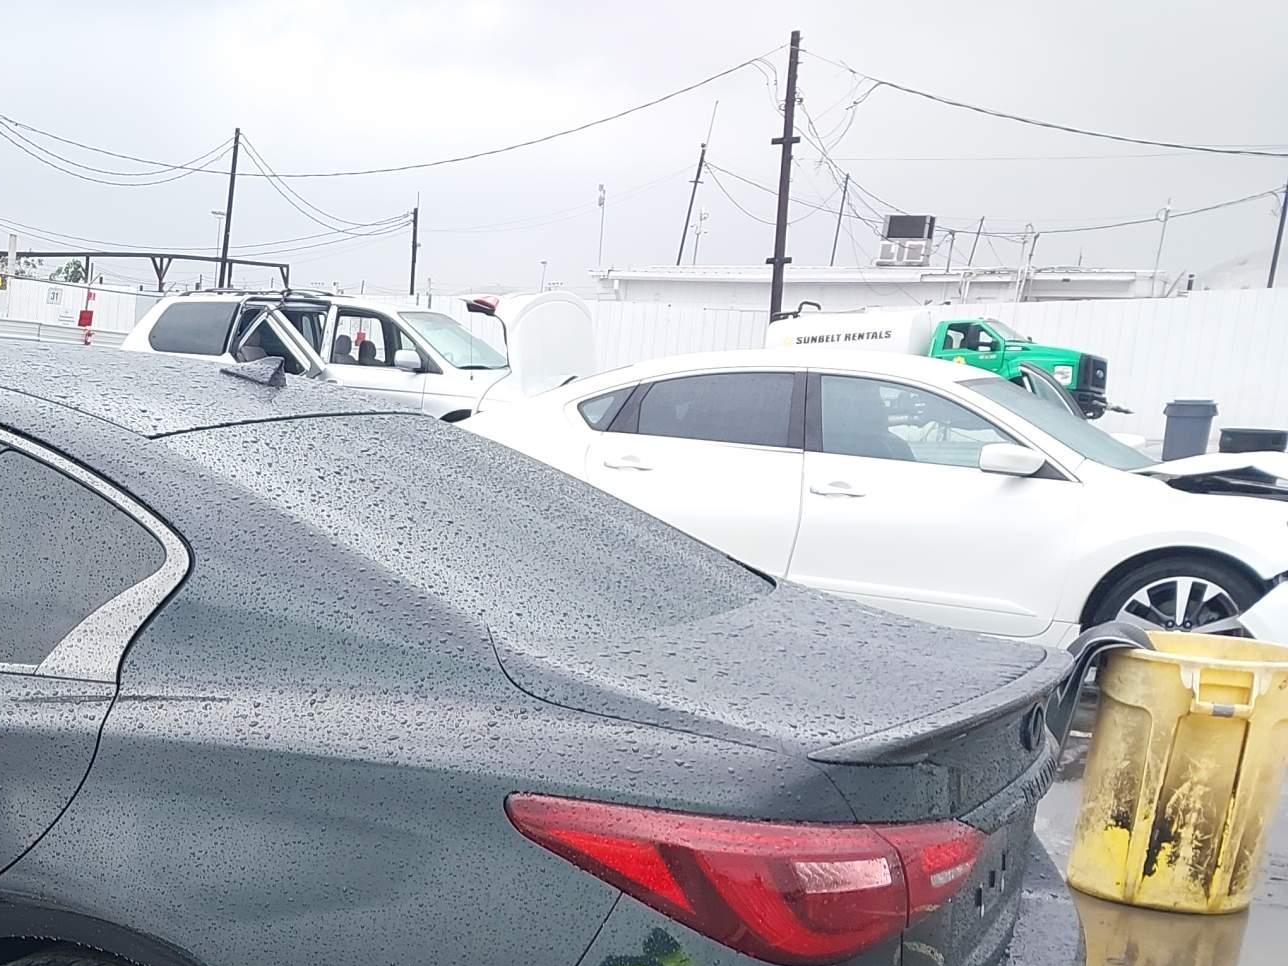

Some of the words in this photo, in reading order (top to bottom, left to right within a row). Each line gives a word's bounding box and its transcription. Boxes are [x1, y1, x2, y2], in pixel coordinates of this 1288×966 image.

[50, 291, 59, 301] 31
[795, 333, 842, 345] SUNBELT
[844, 330, 892, 342] RENTALS
